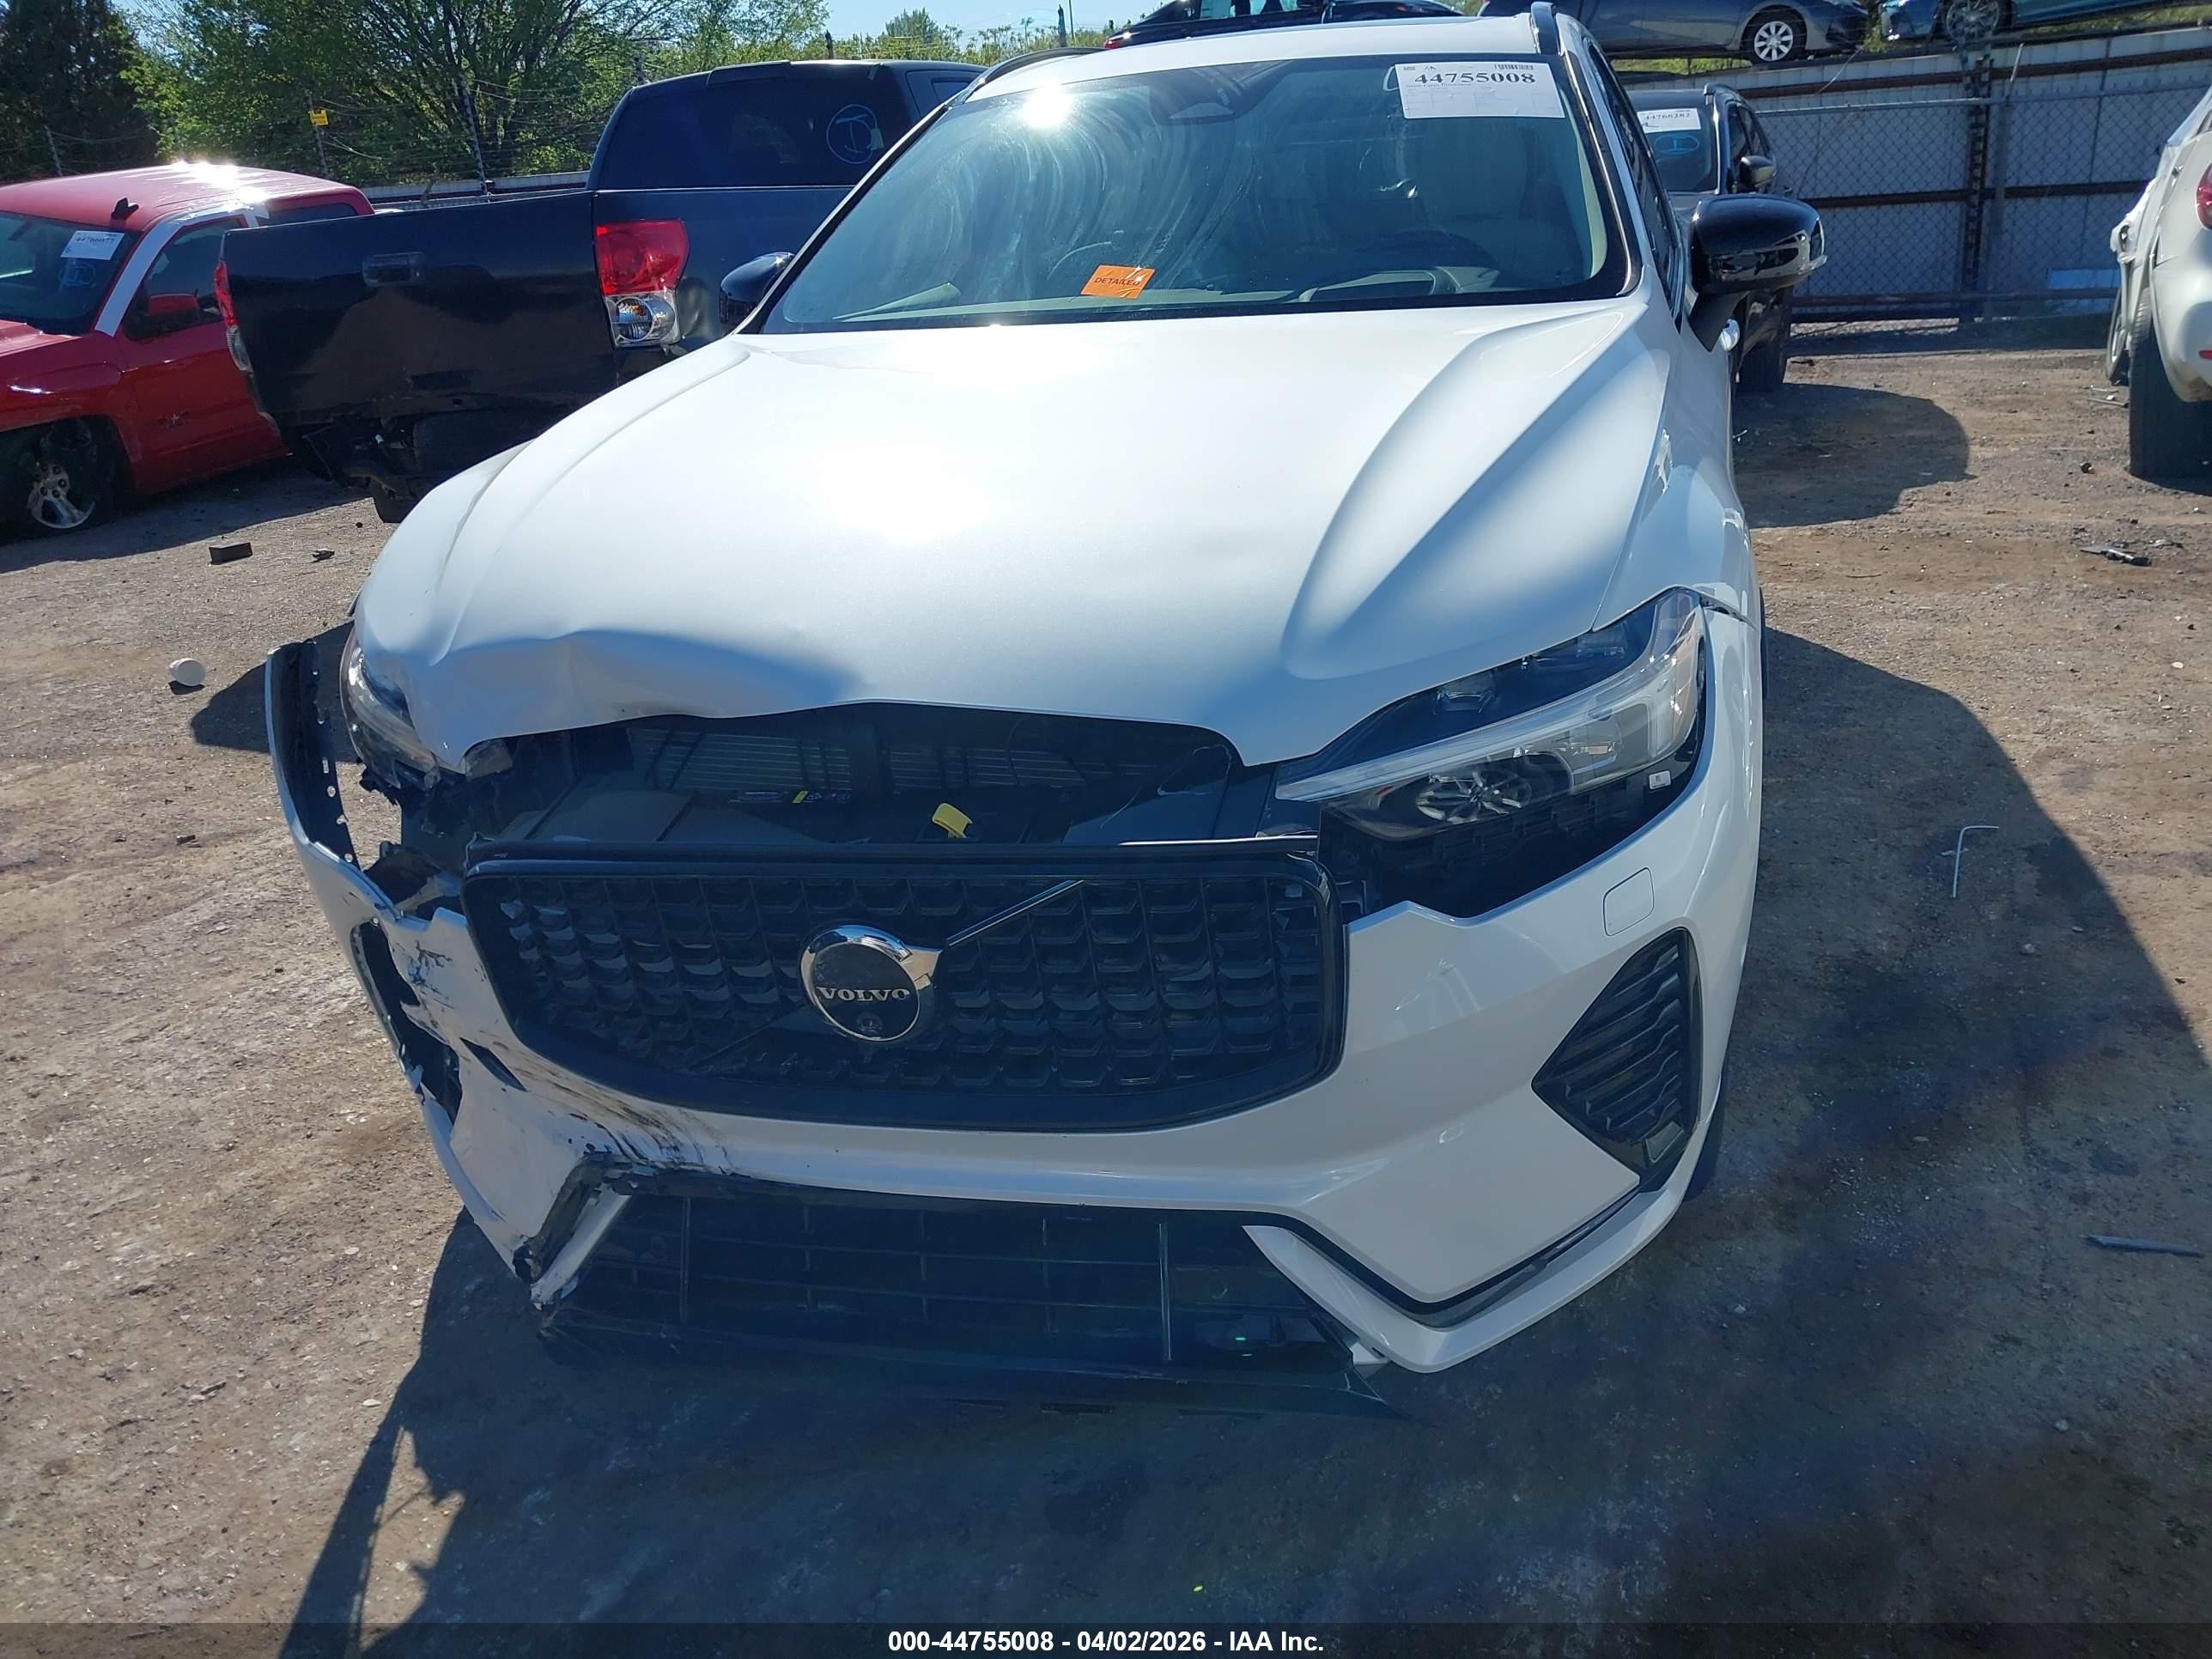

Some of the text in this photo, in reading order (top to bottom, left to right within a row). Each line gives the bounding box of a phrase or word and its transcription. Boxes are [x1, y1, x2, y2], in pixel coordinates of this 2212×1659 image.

[1414, 72, 1536, 84] 44755008
[1095, 276, 1140, 286] DETAILED
[816, 987, 910, 1002] VOLVO
